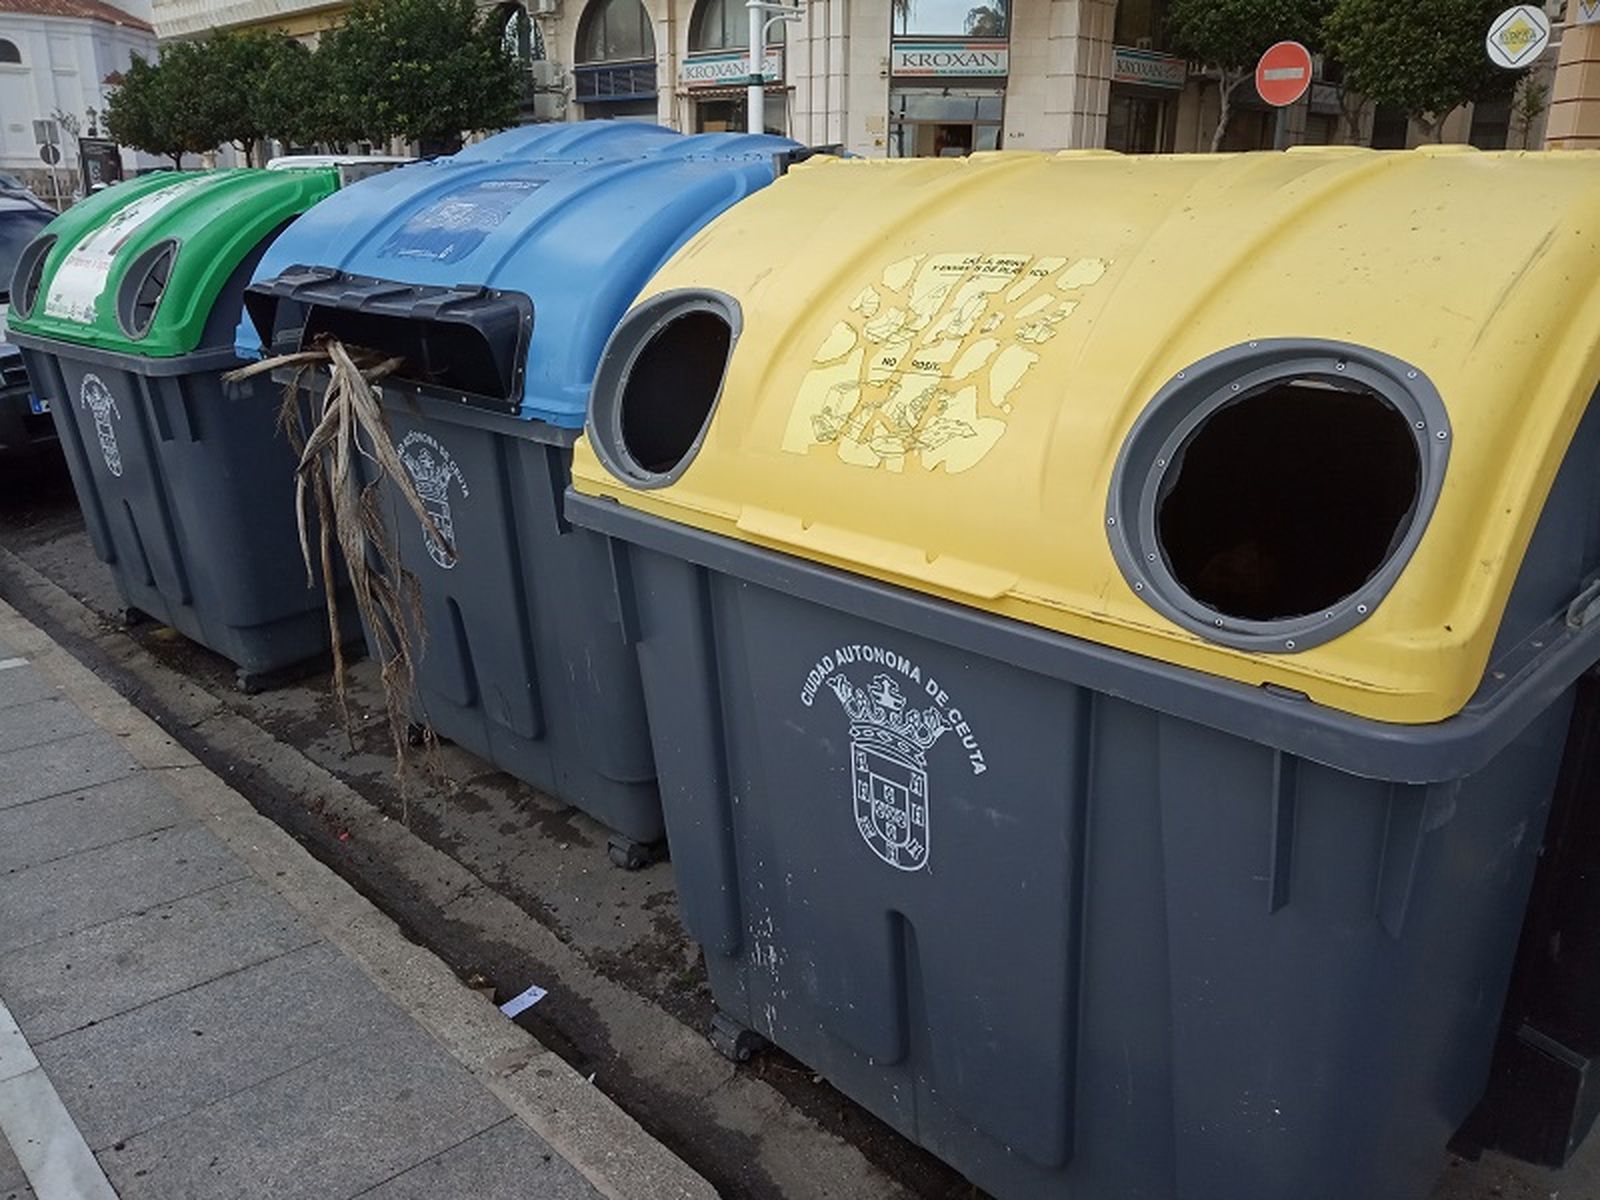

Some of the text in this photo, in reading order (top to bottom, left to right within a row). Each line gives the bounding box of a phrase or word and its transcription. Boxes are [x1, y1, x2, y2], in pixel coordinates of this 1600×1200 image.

[902, 53, 999, 67] KROXAN
[686, 62, 746, 79] KROXAN
[881, 357, 897, 367] NO
[801, 645, 988, 776] CIUDAD AUTONOMA DE CEUTA
